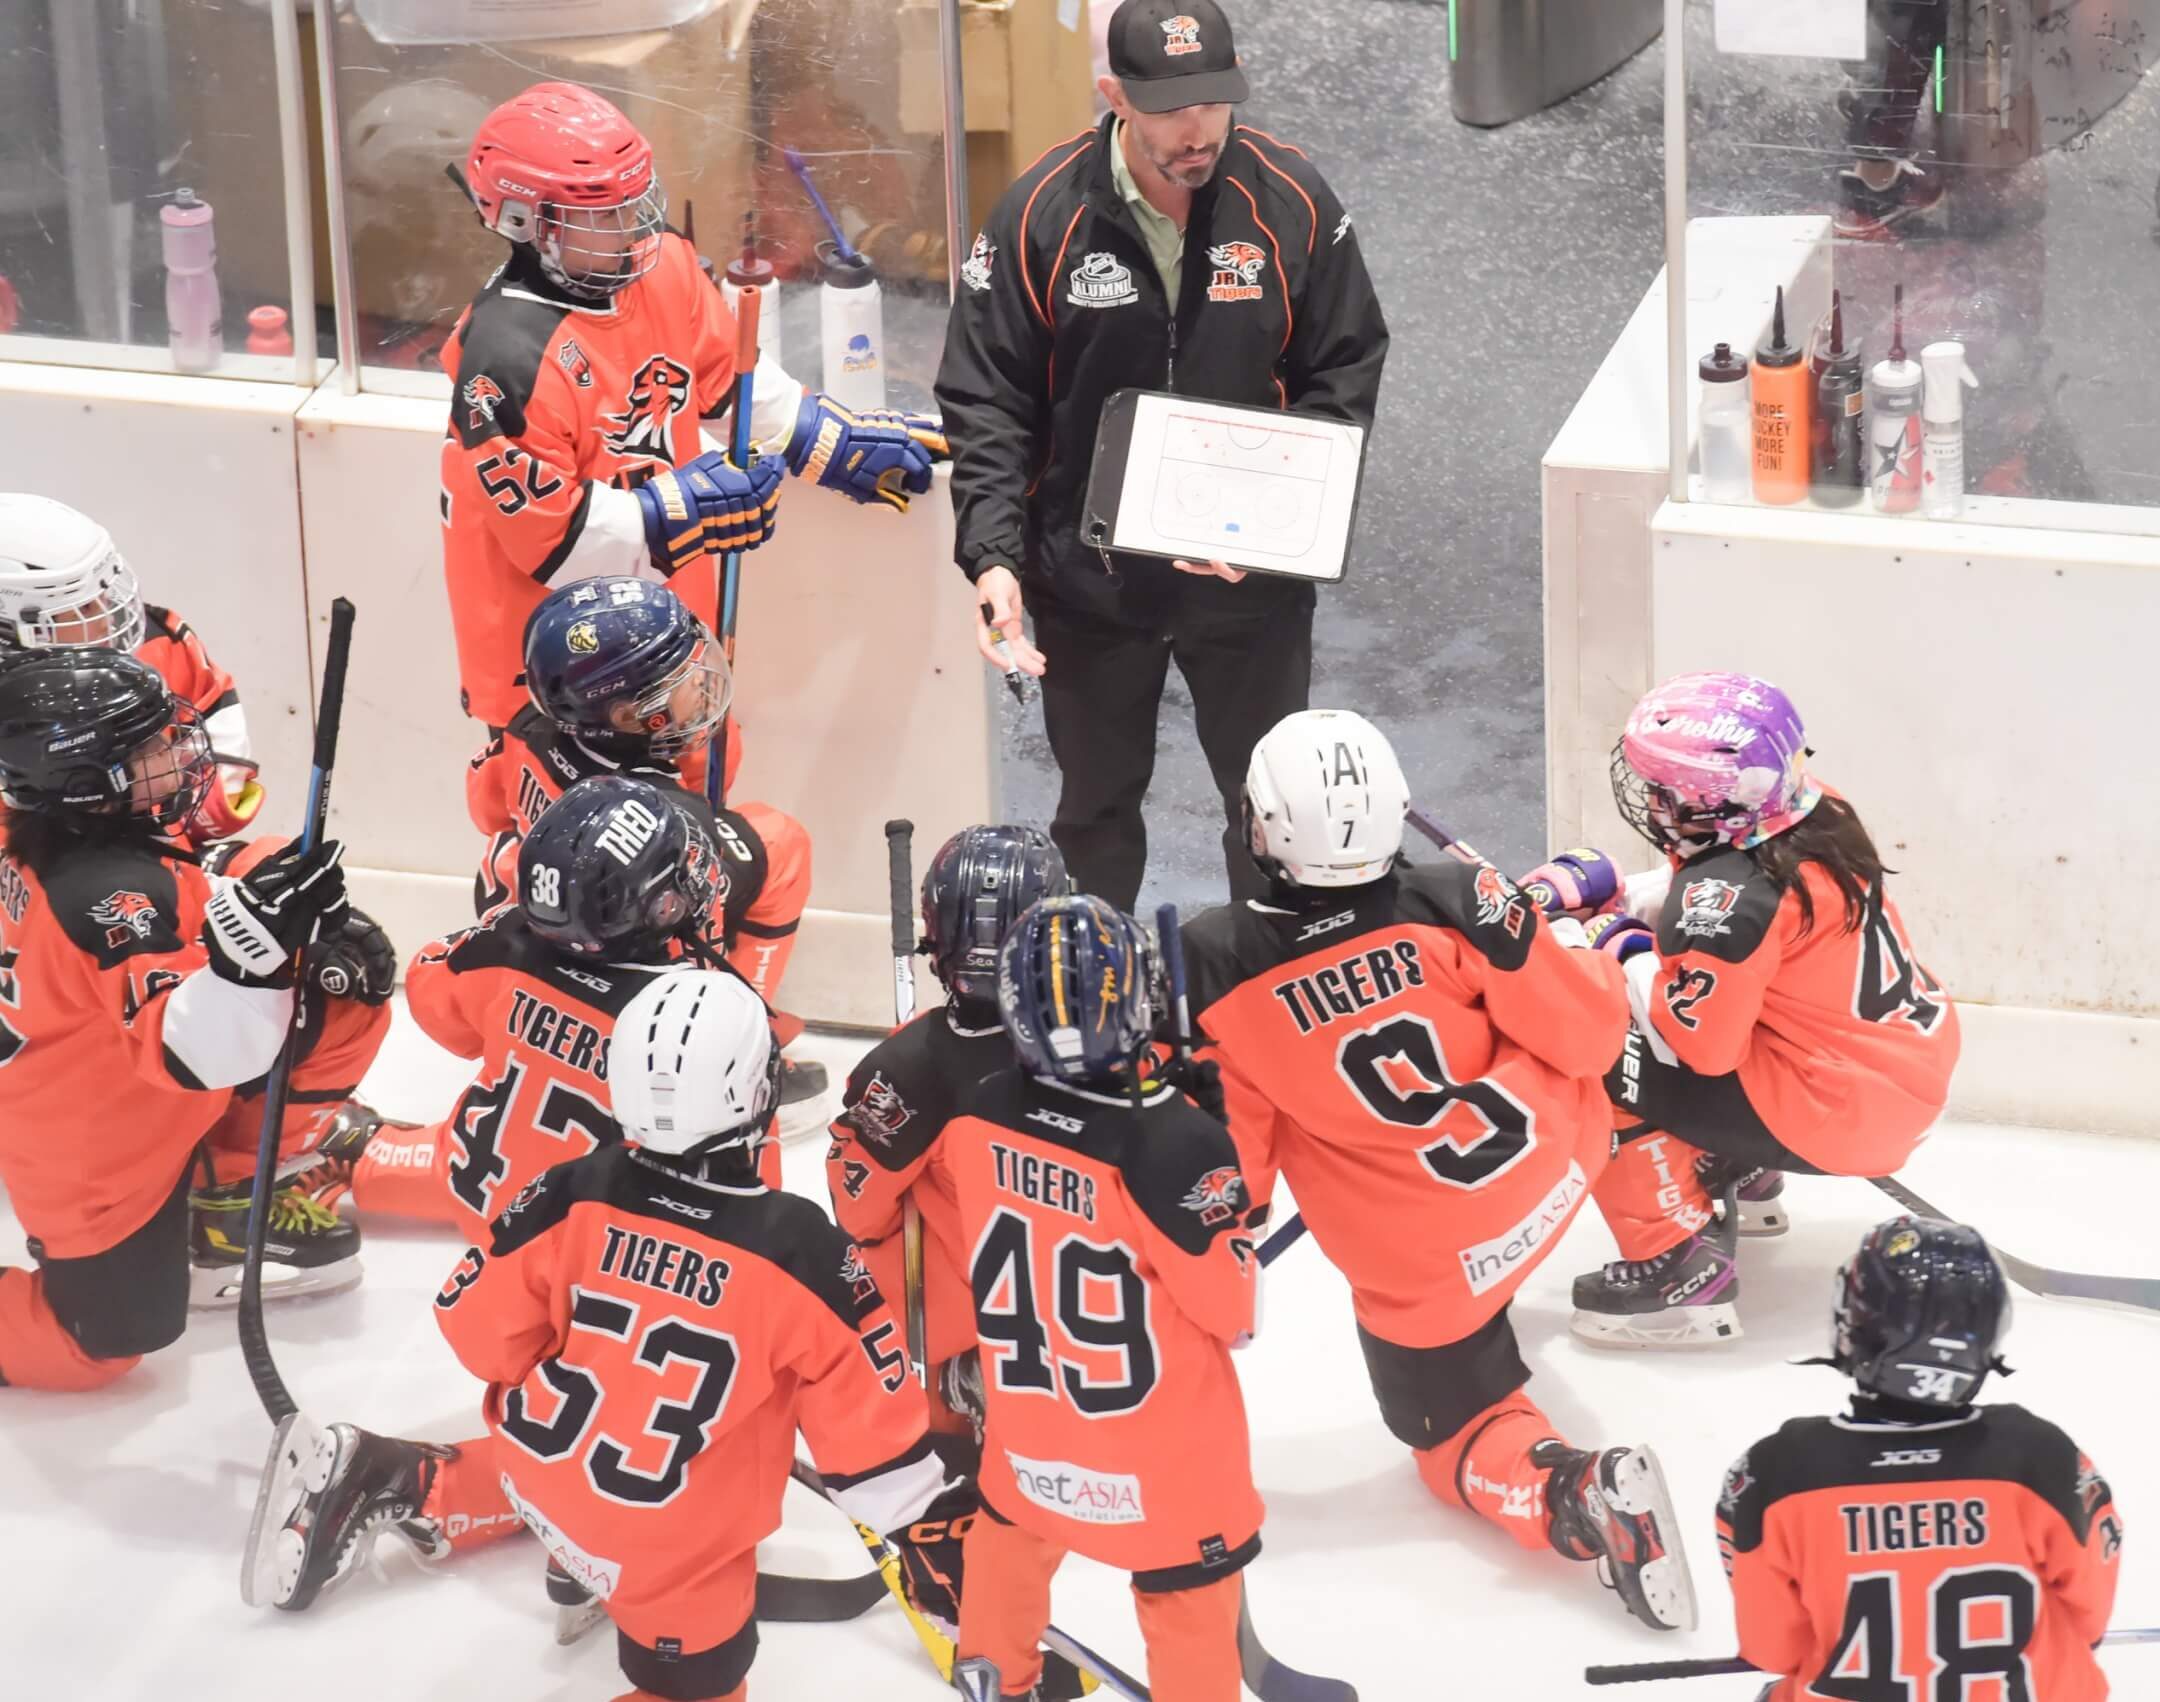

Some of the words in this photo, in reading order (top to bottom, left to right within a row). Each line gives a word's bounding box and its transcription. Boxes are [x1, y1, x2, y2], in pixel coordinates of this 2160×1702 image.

[498, 178, 537, 197] CCM
[620, 158, 648, 180] CCM
[1073, 280, 1131, 298] ALUMNI
[1208, 286, 1262, 300] Tigers
[1213, 271, 1237, 286] JR
[1755, 401, 1784, 420] MORE
[1755, 436, 1784, 454] MORE
[475, 447, 566, 516] 52
[586, 680, 626, 699] CCM
[48, 731, 97, 753] BAUER
[1640, 702, 1757, 748] Dorothy
[548, 747, 580, 781] JOG
[1333, 742, 1360, 786] A
[519, 764, 554, 824] TIG
[595, 799, 659, 866] THEO
[1342, 820, 1355, 848] 7
[531, 863, 560, 908] 38
[1296, 909, 1356, 942] JOG
[556, 965, 613, 993] JOG
[1275, 940, 1425, 1036] TIGERS
[507, 989, 612, 1082] TIGERS
[1025, 1108, 1086, 1133] JOG
[1335, 1010, 1538, 1191] 9
[448, 1050, 626, 1219] 47
[989, 1142, 1096, 1224] TIGERS
[648, 1194, 712, 1221] JOG
[432, 1244, 487, 1310] 3
[602, 1226, 730, 1307] TIGERS
[1666, 1262, 1717, 1305] CCM
[969, 1205, 1163, 1420] 49
[859, 1318, 909, 1394] 5
[498, 1286, 741, 1508] 53
[1908, 1367, 1956, 1402] 34
[1870, 1449, 1942, 1466] JOG
[1014, 1466, 1139, 1512] netASIA
[1840, 1499, 1988, 1555] TIGERS
[1804, 1562, 2042, 1702] 48
